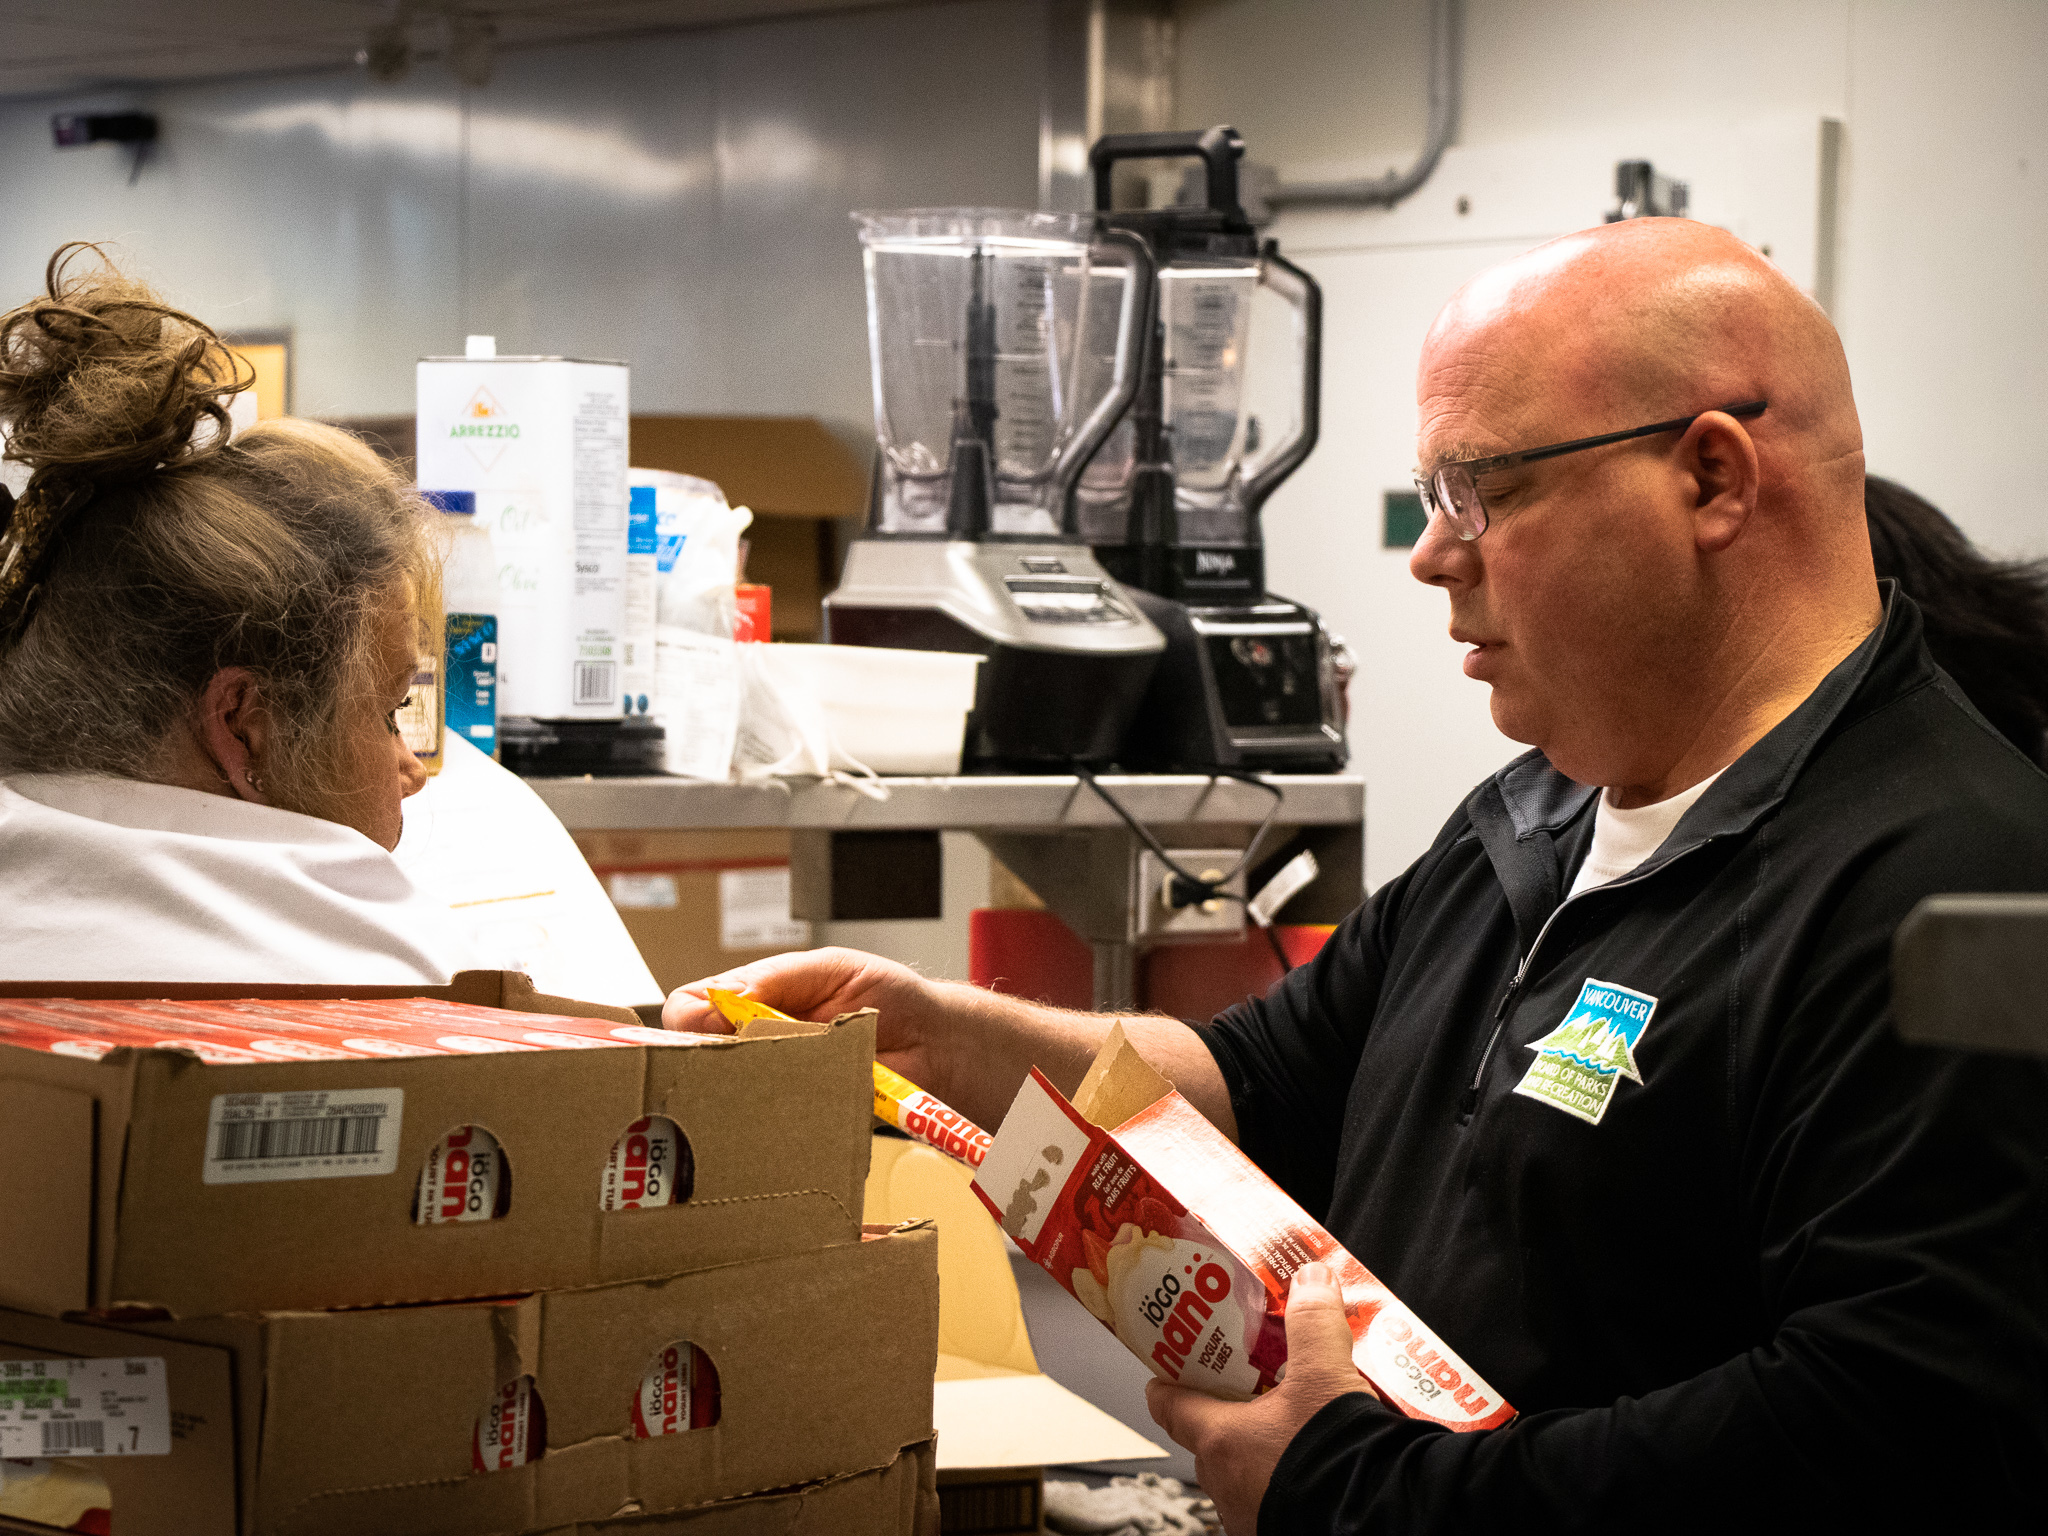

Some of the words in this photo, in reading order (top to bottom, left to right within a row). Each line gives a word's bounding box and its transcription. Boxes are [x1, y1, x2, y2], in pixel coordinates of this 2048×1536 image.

[450, 424, 520, 439] ARREZZIO
[1583, 987, 1649, 1022] VANCOUVER
[1533, 1059, 1560, 1078] BOARD
[1560, 1067, 1573, 1081] OF
[1572, 1072, 1608, 1096] PARKS
[1540, 1080, 1603, 1113] RECREATION
[441, 1126, 473, 1223] nan
[1091, 1172, 1106, 1191] REAL
[1102, 1152, 1119, 1175] FRUIT
[1104, 1186, 1121, 1209] VRAIS
[1117, 1164, 1137, 1190] FRUITS
[1048, 1231, 1064, 1261] AGROPUR
[1292, 1242, 1312, 1263] OLORANT
[1272, 1249, 1296, 1278] RTIFICIAL
[1276, 1267, 1289, 1280] NO
[1198, 1325, 1226, 1369] YOGURT
[1210, 1342, 1233, 1375] TUBES
[128, 1425, 139, 1451] 7
